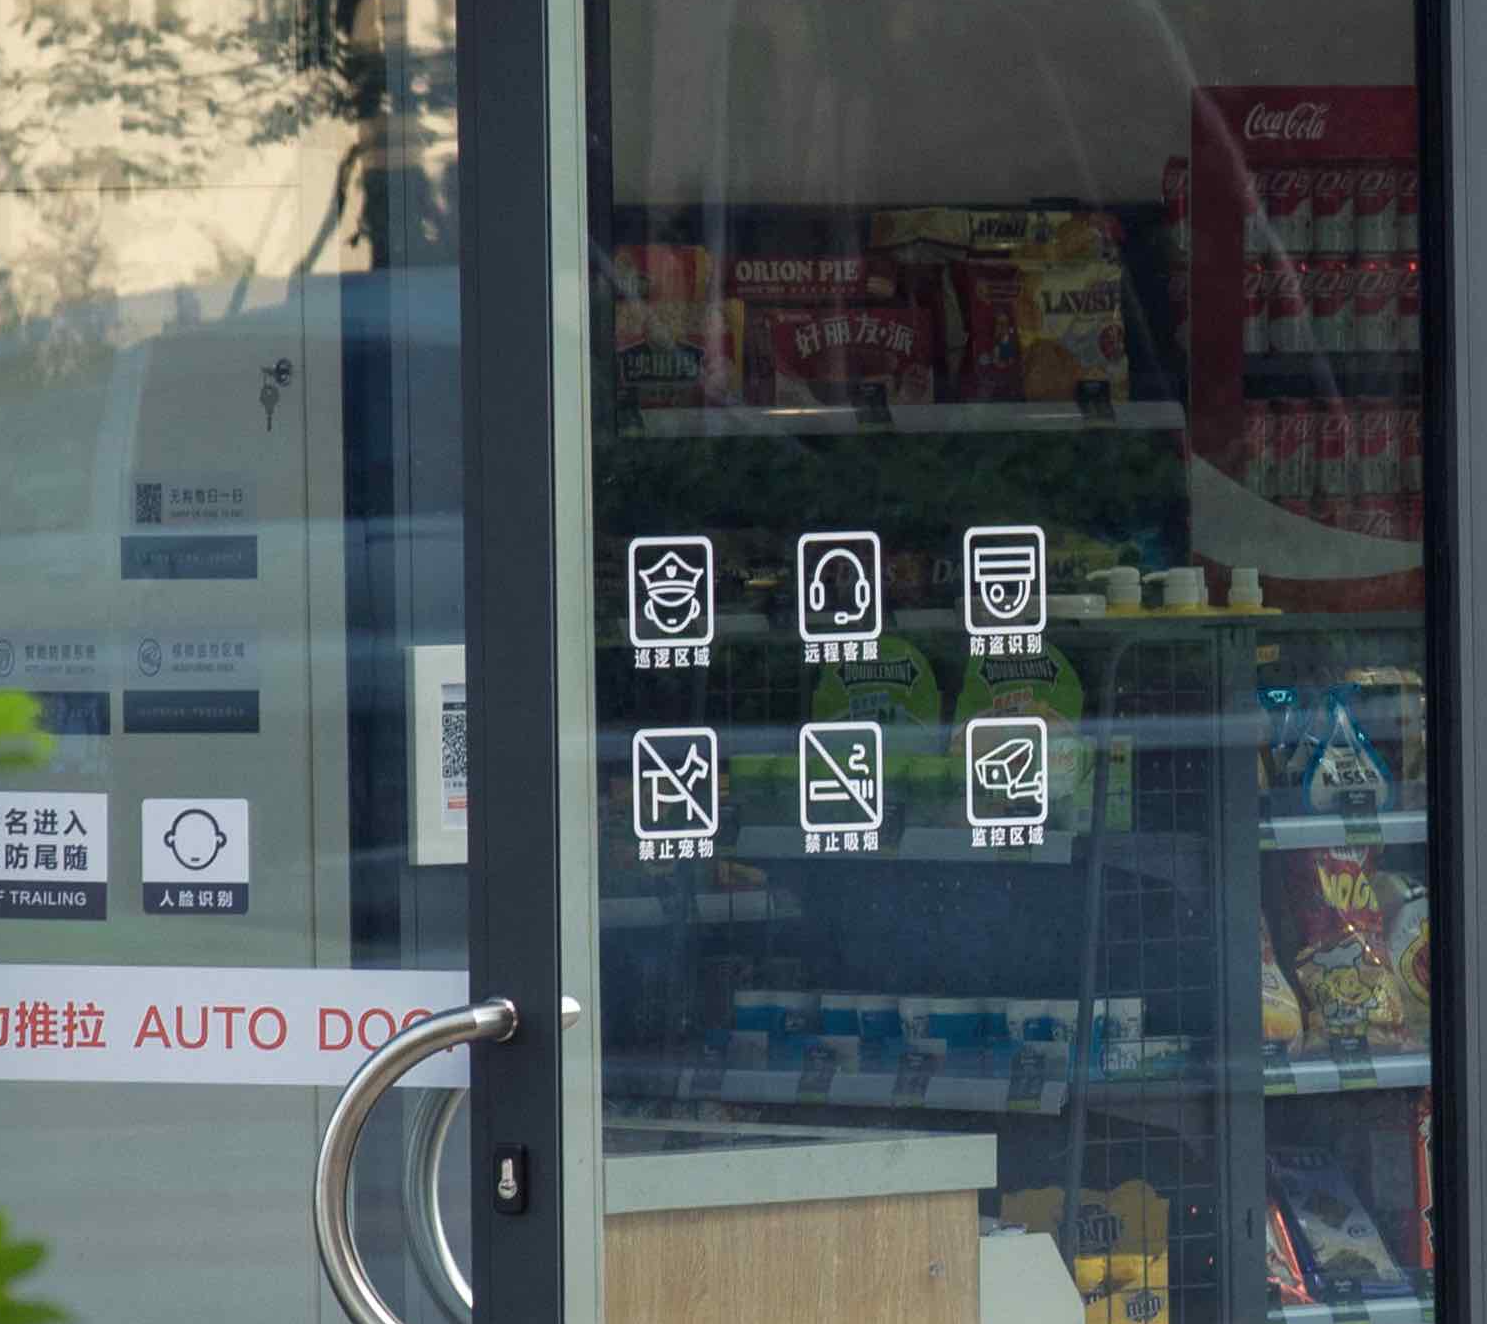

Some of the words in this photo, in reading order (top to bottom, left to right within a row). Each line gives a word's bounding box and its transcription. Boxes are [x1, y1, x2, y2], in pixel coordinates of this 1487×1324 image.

[735, 260, 812, 283] ORION
[817, 260, 860, 283] PIE
[804, 641, 879, 663] 远程客服
[969, 635, 1043, 656] 防盗识别
[634, 647, 711, 669] 巡逻区域
[804, 832, 879, 854] 禁止吸烟
[971, 826, 1045, 847] 监控区域
[638, 838, 714, 860] 禁止宠物
[9, 890, 88, 907] TRAILING
[159, 890, 234, 909] 人脸识别
[134, 1005, 289, 1051] AUTO
[318, 1006, 456, 1052] DO
